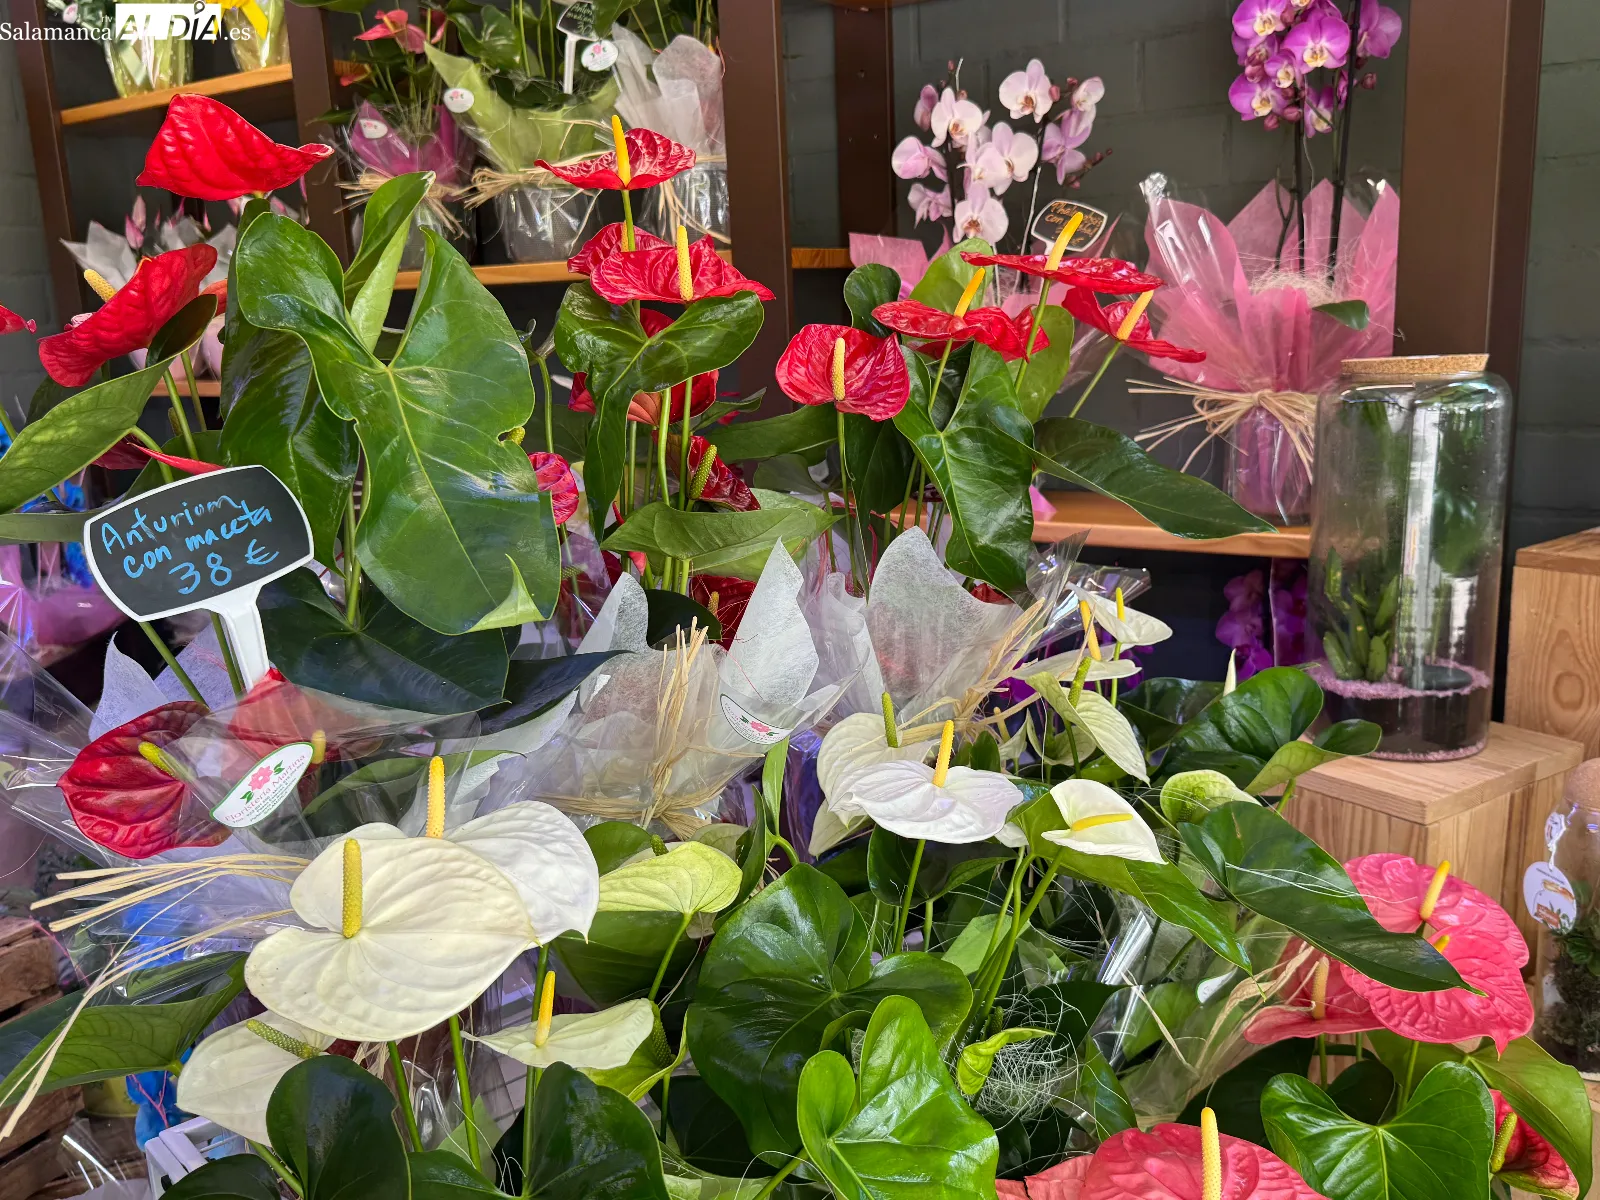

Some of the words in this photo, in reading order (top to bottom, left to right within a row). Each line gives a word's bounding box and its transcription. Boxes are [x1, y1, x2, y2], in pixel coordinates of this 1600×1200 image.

[123, 545, 172, 579] con
[186, 500, 273, 551] maceta
[168, 552, 233, 595] 38
[244, 538, 280, 566] €
[272, 755, 305, 787] Martina
